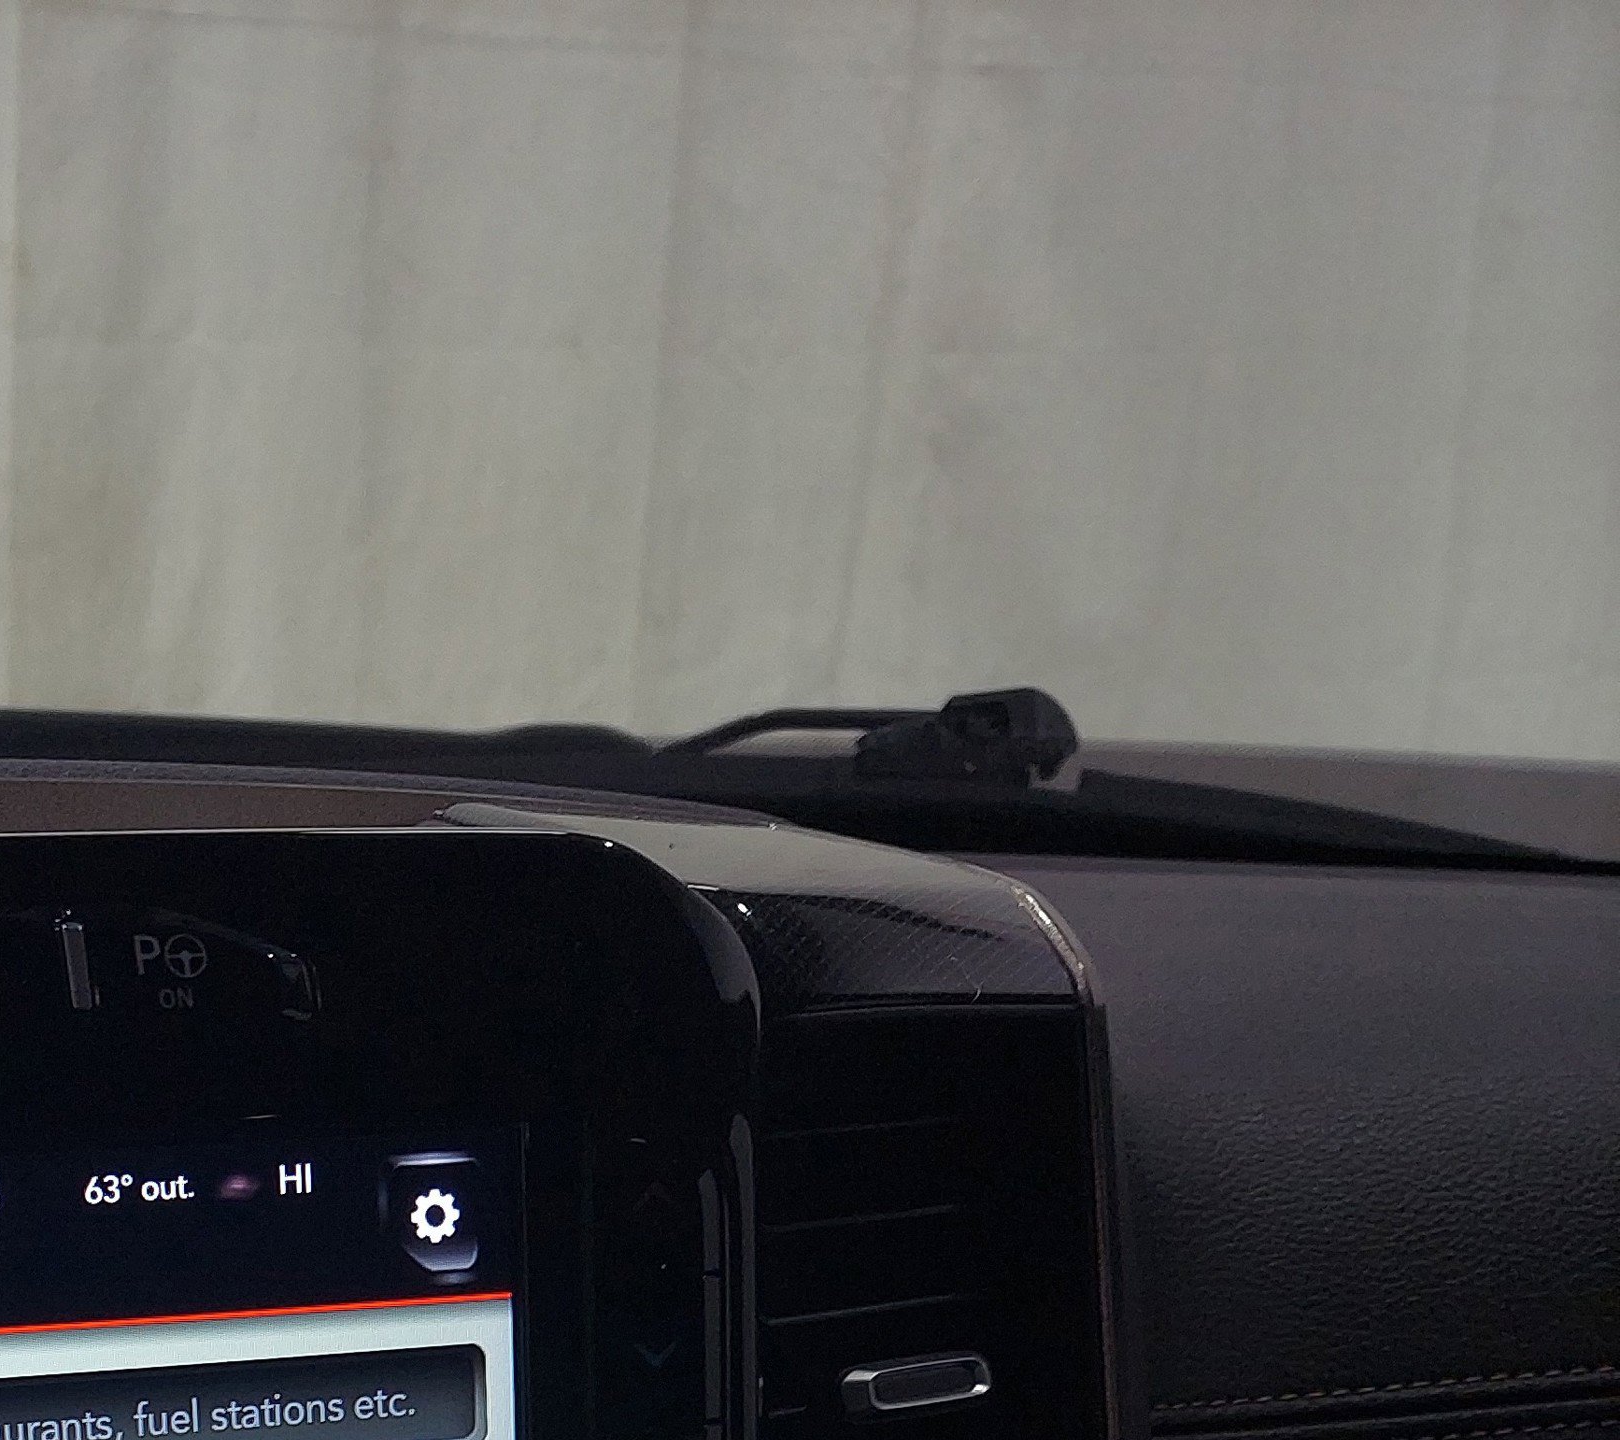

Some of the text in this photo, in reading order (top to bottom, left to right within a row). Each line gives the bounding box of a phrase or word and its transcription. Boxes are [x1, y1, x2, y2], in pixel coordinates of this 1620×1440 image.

[158, 987, 195, 1011] ON
[84, 1174, 195, 1205] 63° out.
[279, 1163, 313, 1196] HI
[133, 1397, 199, 1438] fuel
[211, 1392, 344, 1433] stations
[354, 1389, 416, 1421] etc.
